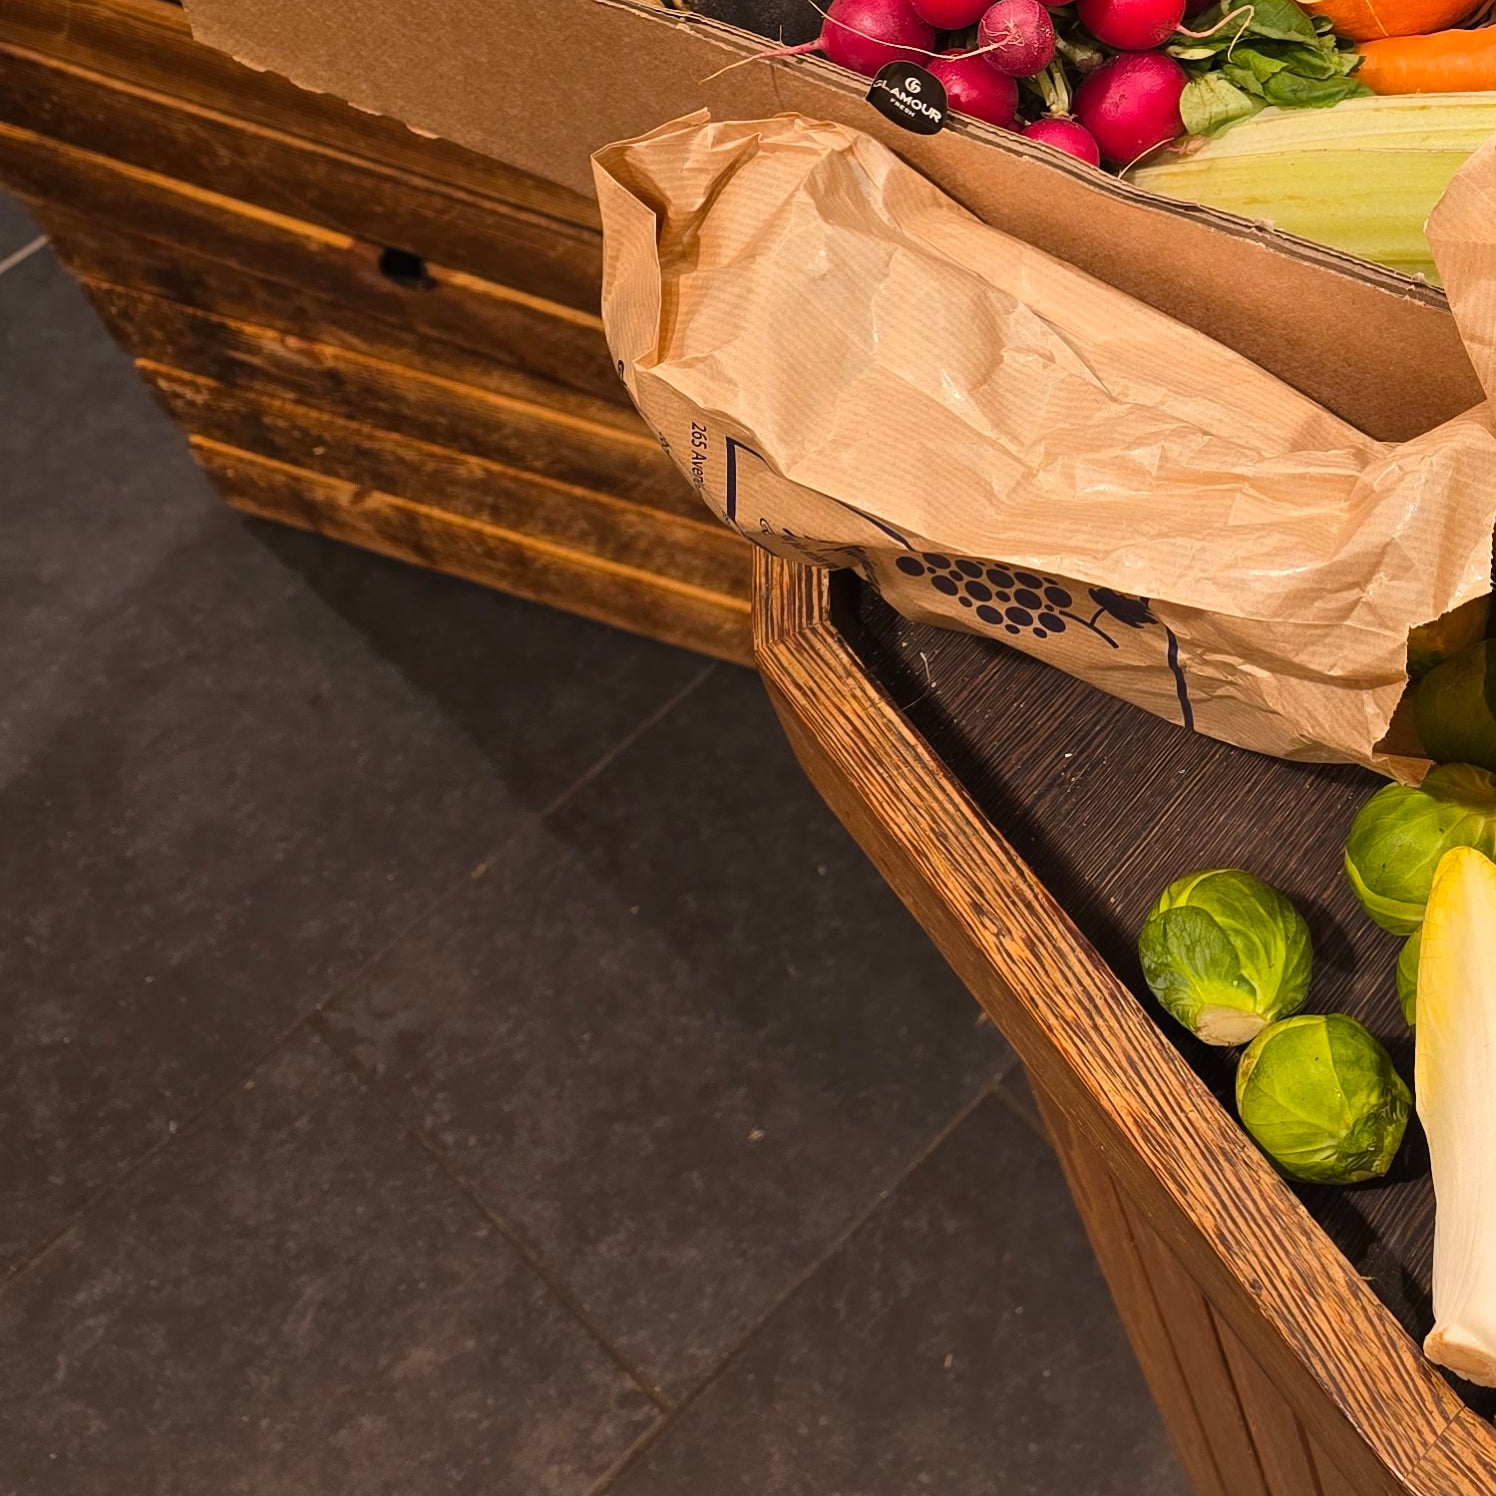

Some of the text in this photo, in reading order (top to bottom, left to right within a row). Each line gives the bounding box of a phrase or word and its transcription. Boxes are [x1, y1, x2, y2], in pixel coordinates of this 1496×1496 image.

[872, 79, 942, 123] GLAMOUR
[889, 97, 916, 117] FRESH
[692, 421, 707, 450] 265
